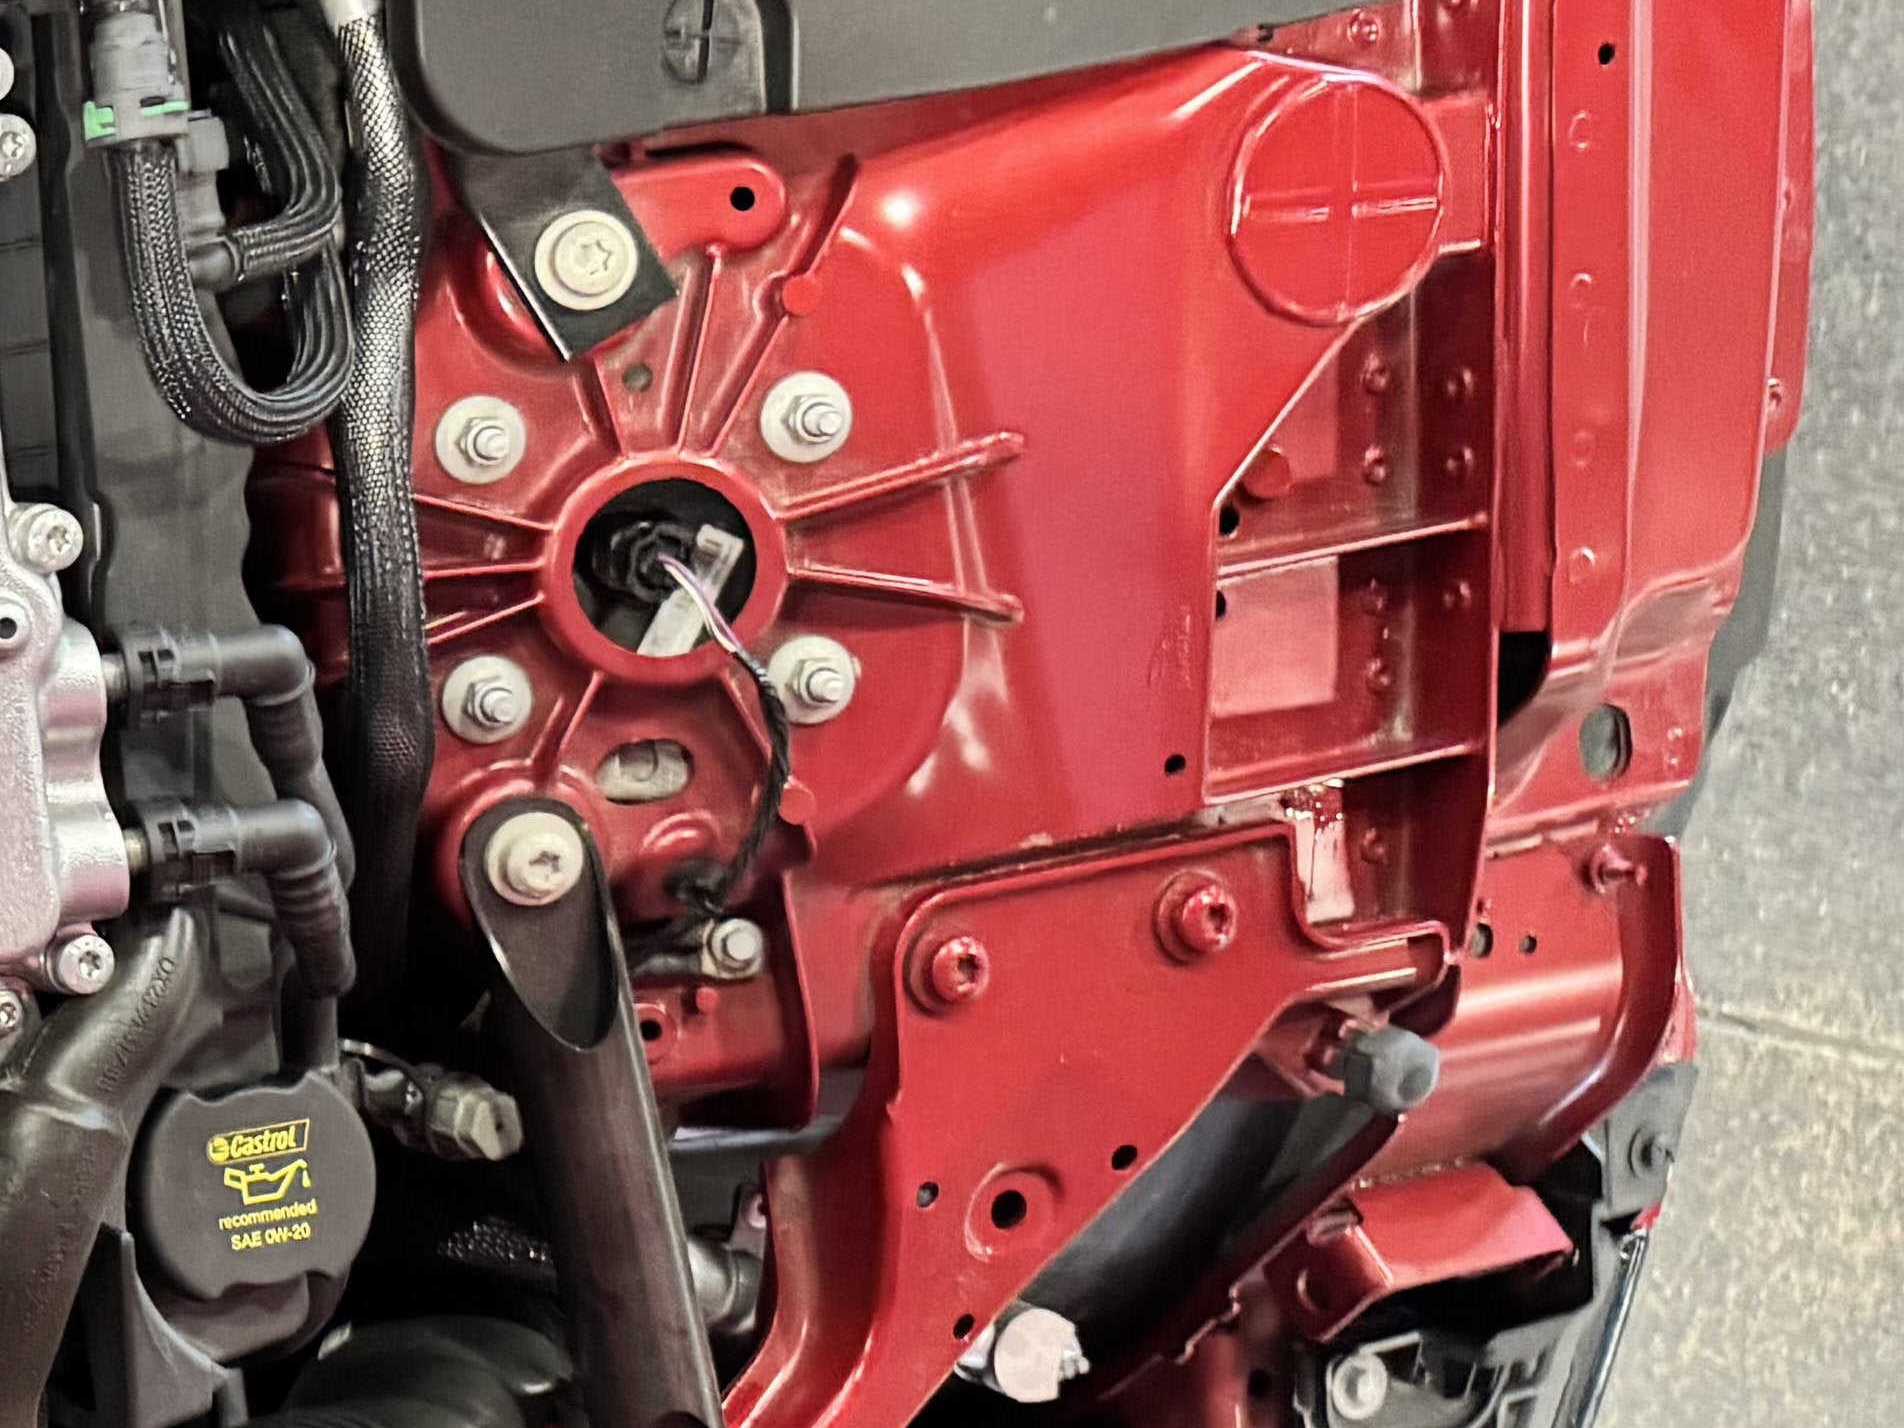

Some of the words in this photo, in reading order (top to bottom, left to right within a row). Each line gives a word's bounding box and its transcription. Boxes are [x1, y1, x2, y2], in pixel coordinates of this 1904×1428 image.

[228, 1123, 297, 1159] Castrol
[218, 1198, 318, 1231] recommended
[230, 1230, 263, 1252] SAE
[264, 1223, 312, 1248] 0W-20
